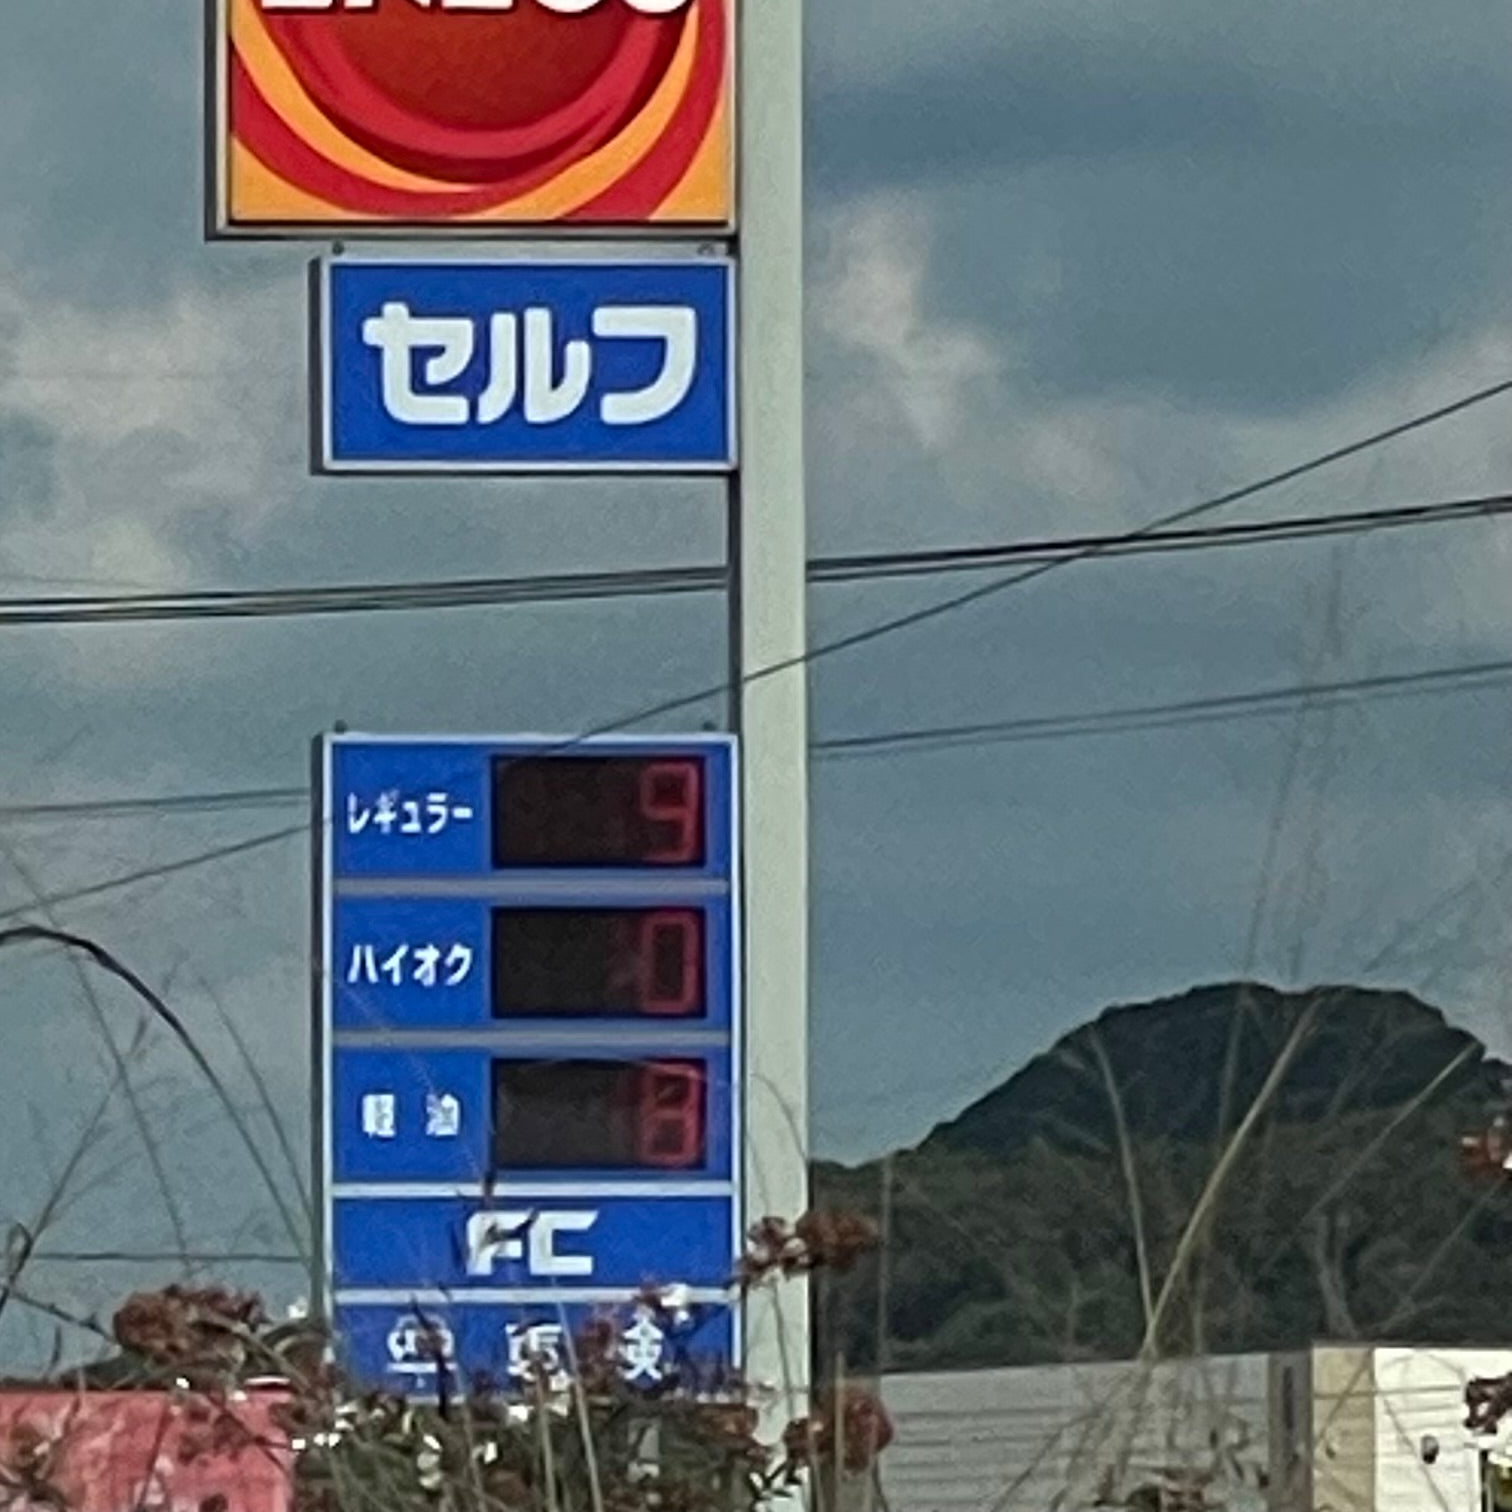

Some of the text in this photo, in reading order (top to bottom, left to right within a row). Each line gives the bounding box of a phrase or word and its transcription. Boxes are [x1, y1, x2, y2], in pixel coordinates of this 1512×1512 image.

[362, 302, 695, 424] セルフ
[347, 790, 473, 834] レギュラー
[347, 944, 473, 987] ハイオク
[465, 1210, 599, 1276] FC
